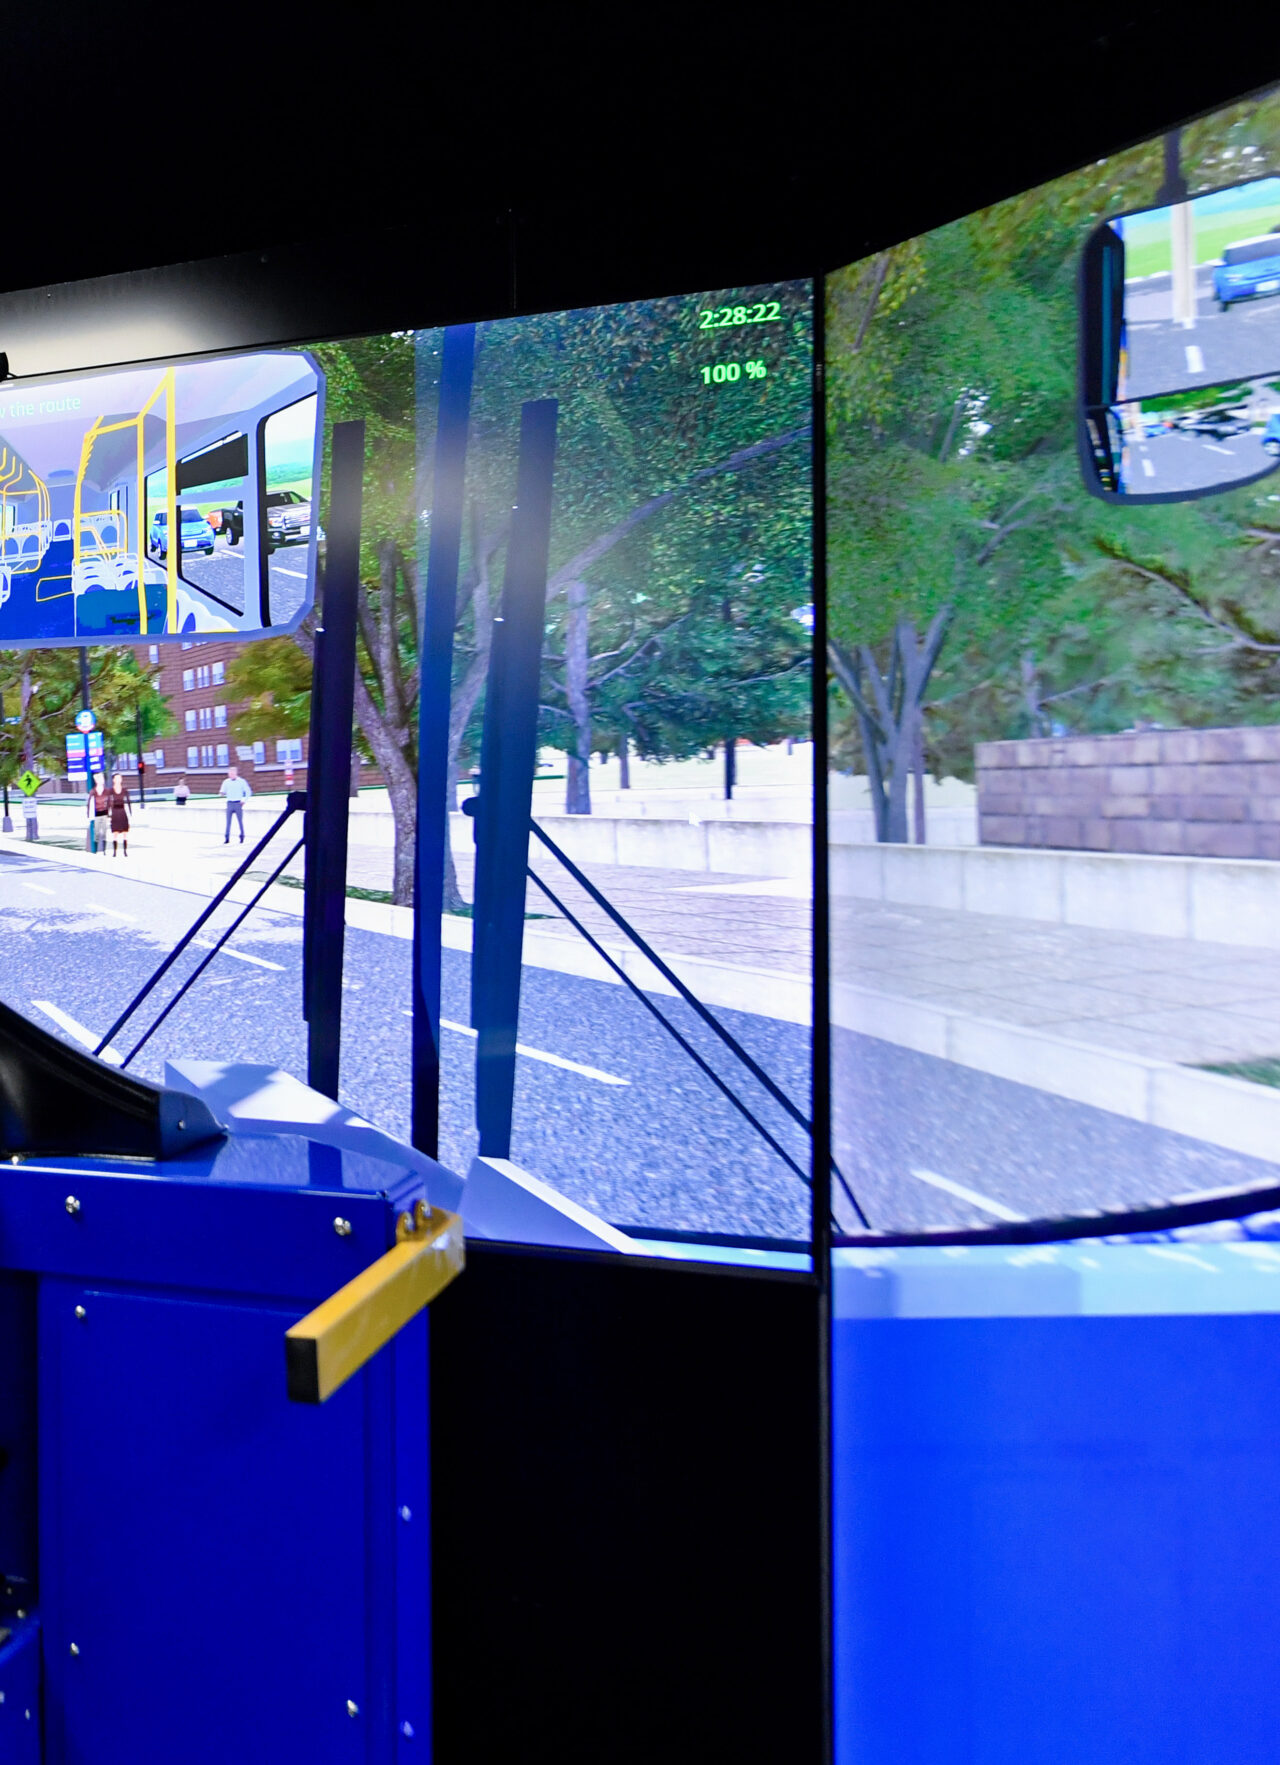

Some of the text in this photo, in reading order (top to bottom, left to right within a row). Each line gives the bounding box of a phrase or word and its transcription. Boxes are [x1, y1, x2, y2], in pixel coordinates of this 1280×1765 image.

[699, 301, 782, 330] 2:28:22
[700, 359, 768, 385] 100 %
[9, 401, 35, 418] the
[39, 396, 81, 415] route
